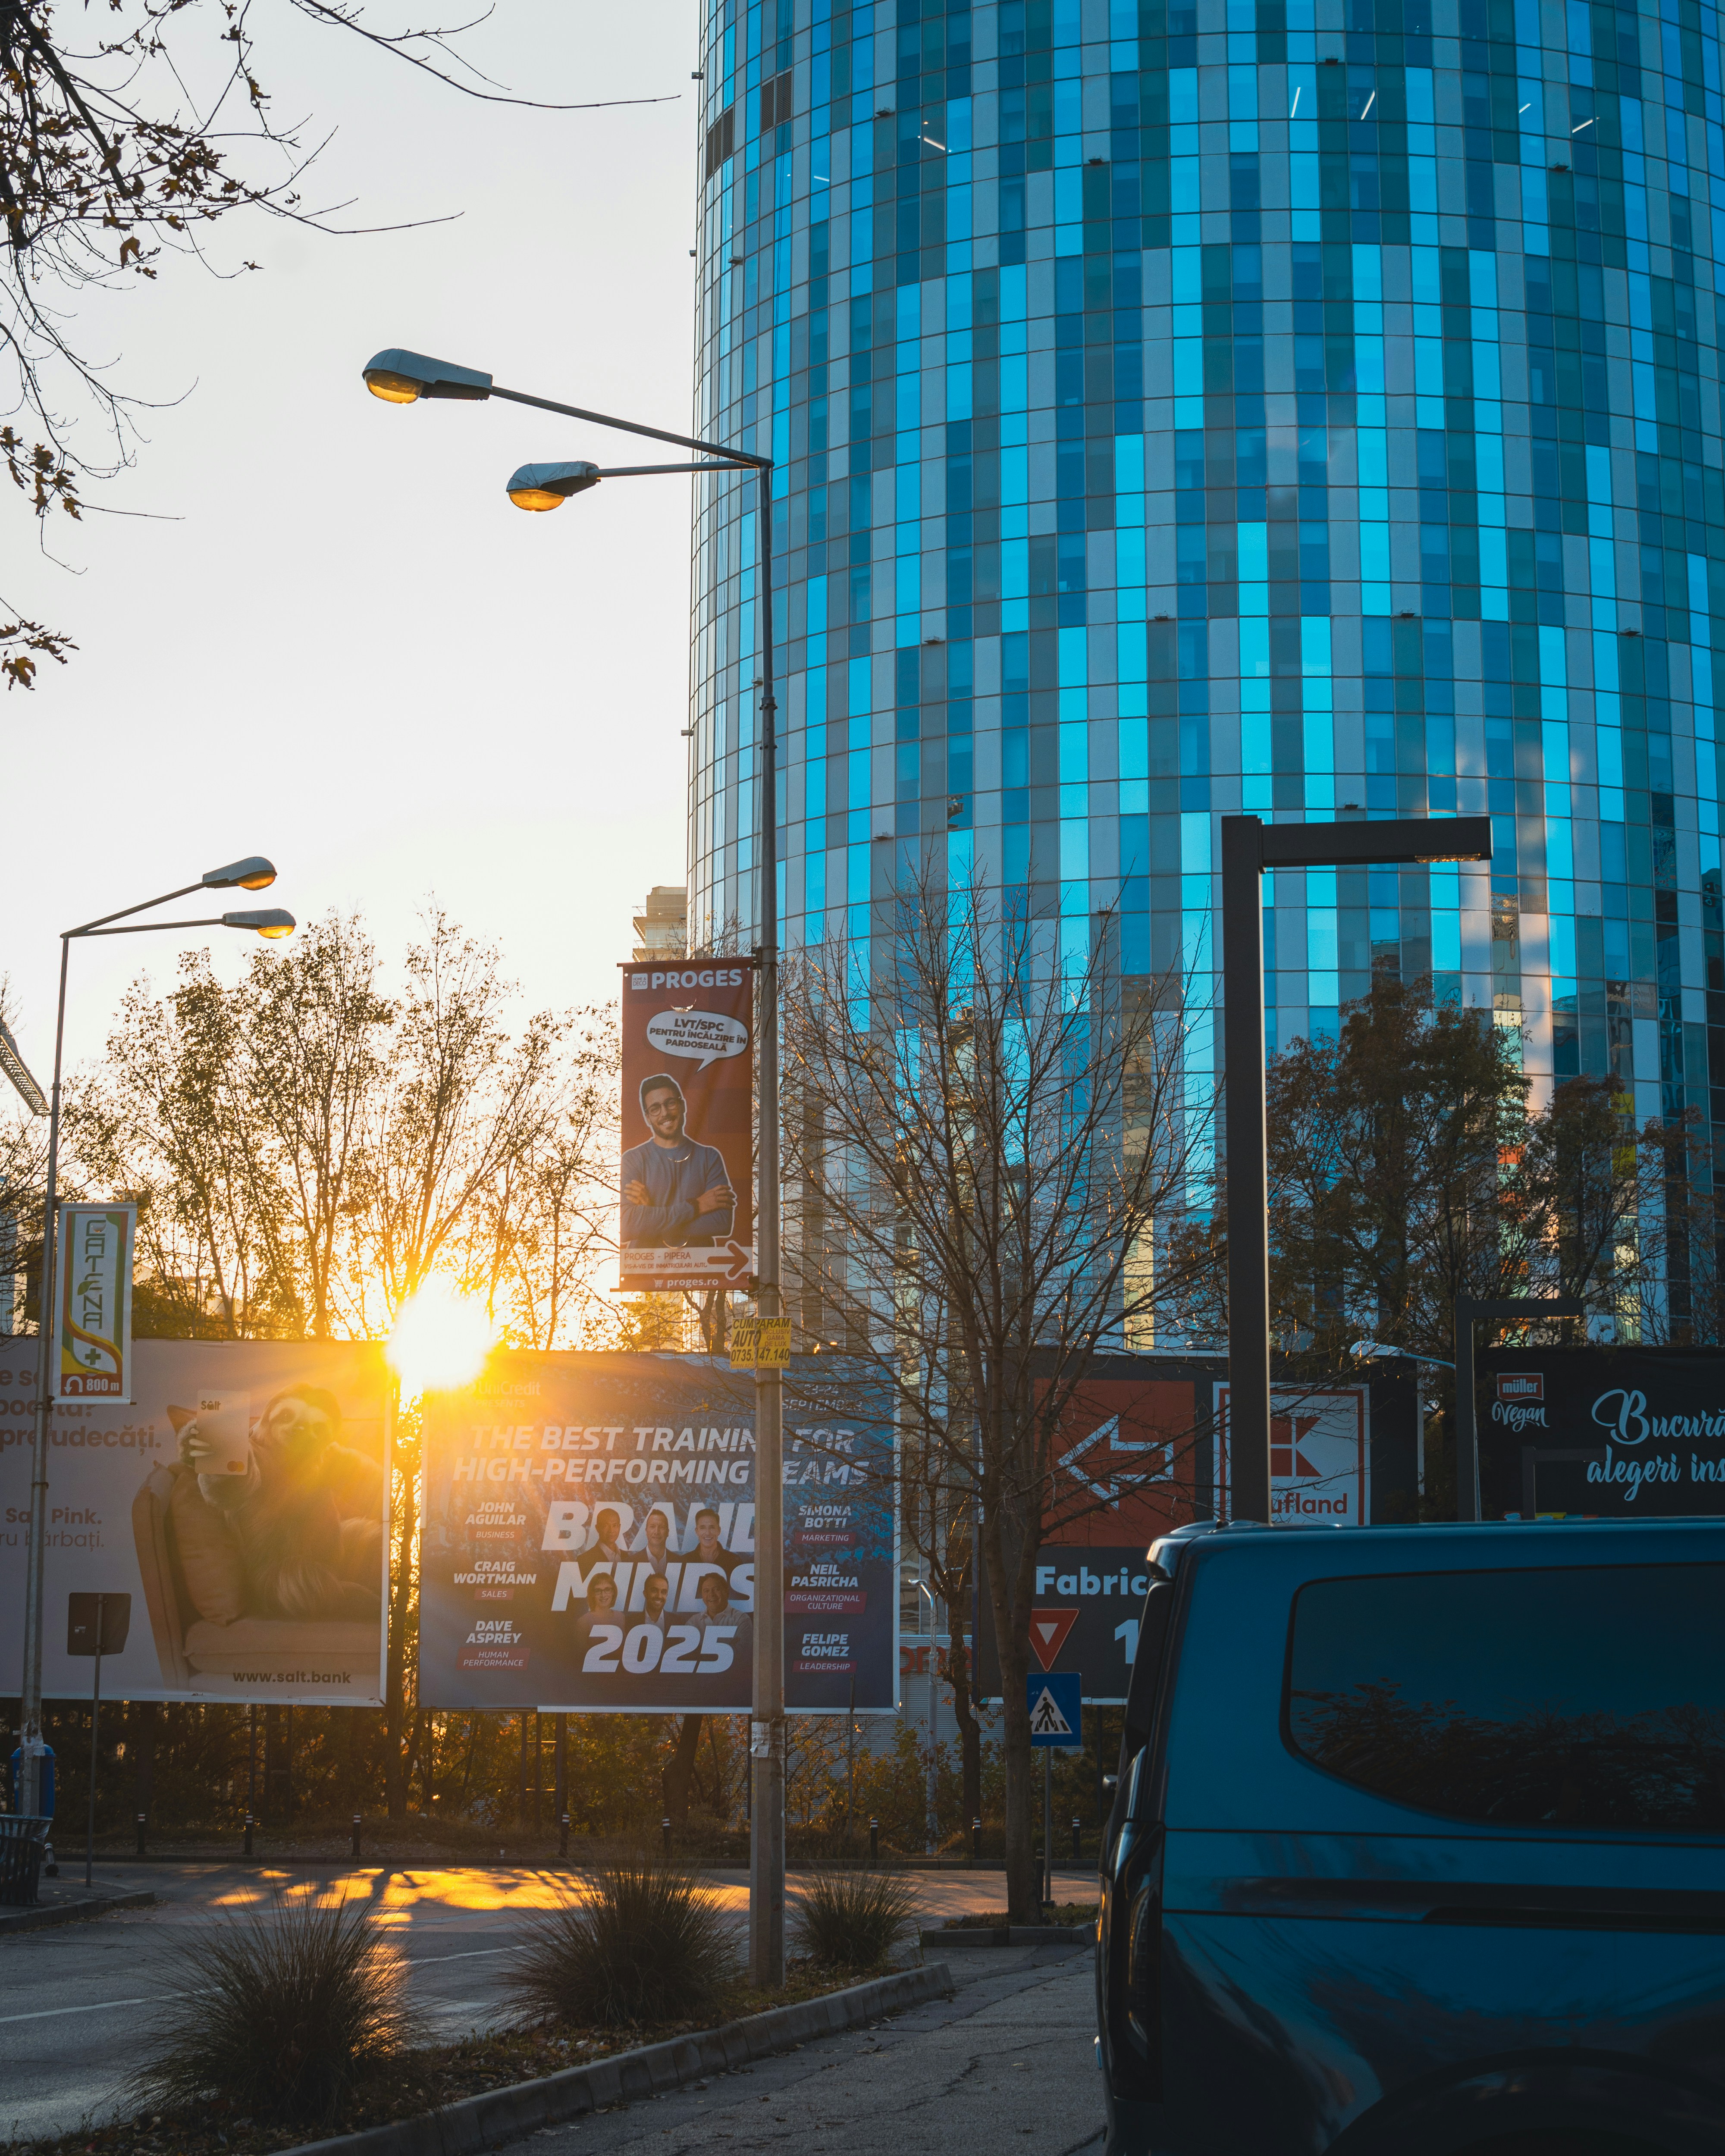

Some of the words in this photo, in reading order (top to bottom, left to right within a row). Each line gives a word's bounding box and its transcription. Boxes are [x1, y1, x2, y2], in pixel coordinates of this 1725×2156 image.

[652, 969, 742, 989] PROGES
[674, 1018, 725, 1032] LVT/SPC
[649, 1028, 685, 1037] PENTRU
[687, 1029, 735, 1043] ÎNCĂLZIRE
[737, 1035, 747, 1044] ÎN
[665, 1038, 728, 1052] PARDOSEALĂ
[624, 1252, 655, 1260] PROGES
[664, 1251, 691, 1260] PIPERA
[82, 1219, 107, 1329] CATENA
[667, 1279, 719, 1288] proges.ro
[733, 1318, 790, 1329] CUMPARAM
[732, 1329, 762, 1348] AUTO
[86, 1379, 108, 1391] 800
[110, 1382, 119, 1391] m
[478, 1381, 541, 1395] UniCredit
[1502, 1378, 1538, 1393] müller
[476, 1399, 525, 1408] PRESENTS
[1492, 1401, 1550, 1432] Vegan
[470, 1425, 534, 1449] THE
[541, 1426, 624, 1451] BEST
[633, 1427, 756, 1452] TRAININ
[792, 1429, 855, 1453] FOR
[453, 1457, 750, 1484] HIGH-PERFORMING
[782, 1460, 869, 1485] EAMS
[1587, 1444, 1681, 1501] alegeri
[477, 1502, 515, 1513] JOHN
[798, 1505, 852, 1516] SIMONA
[51, 1507, 102, 1524] Pink.
[465, 1514, 527, 1525] AGUILAR
[804, 1517, 847, 1528] BOTTI
[474, 1561, 516, 1572] CRAIG
[810, 1564, 840, 1575] NEIL
[453, 1573, 537, 1584] WORTMANN
[791, 1576, 859, 1587] PASRICHA
[1036, 1566, 1157, 1595] Fabric
[790, 1594, 860, 1602] ORGANIZATIONAL
[475, 1620, 513, 1631] DAVE
[465, 1633, 522, 1644] ASPREY
[802, 1633, 849, 1645] FELIPE
[582, 1624, 738, 1674] 2025
[801, 1645, 850, 1657] GOMEZ
[233, 1671, 351, 1683] www.salt.bank
